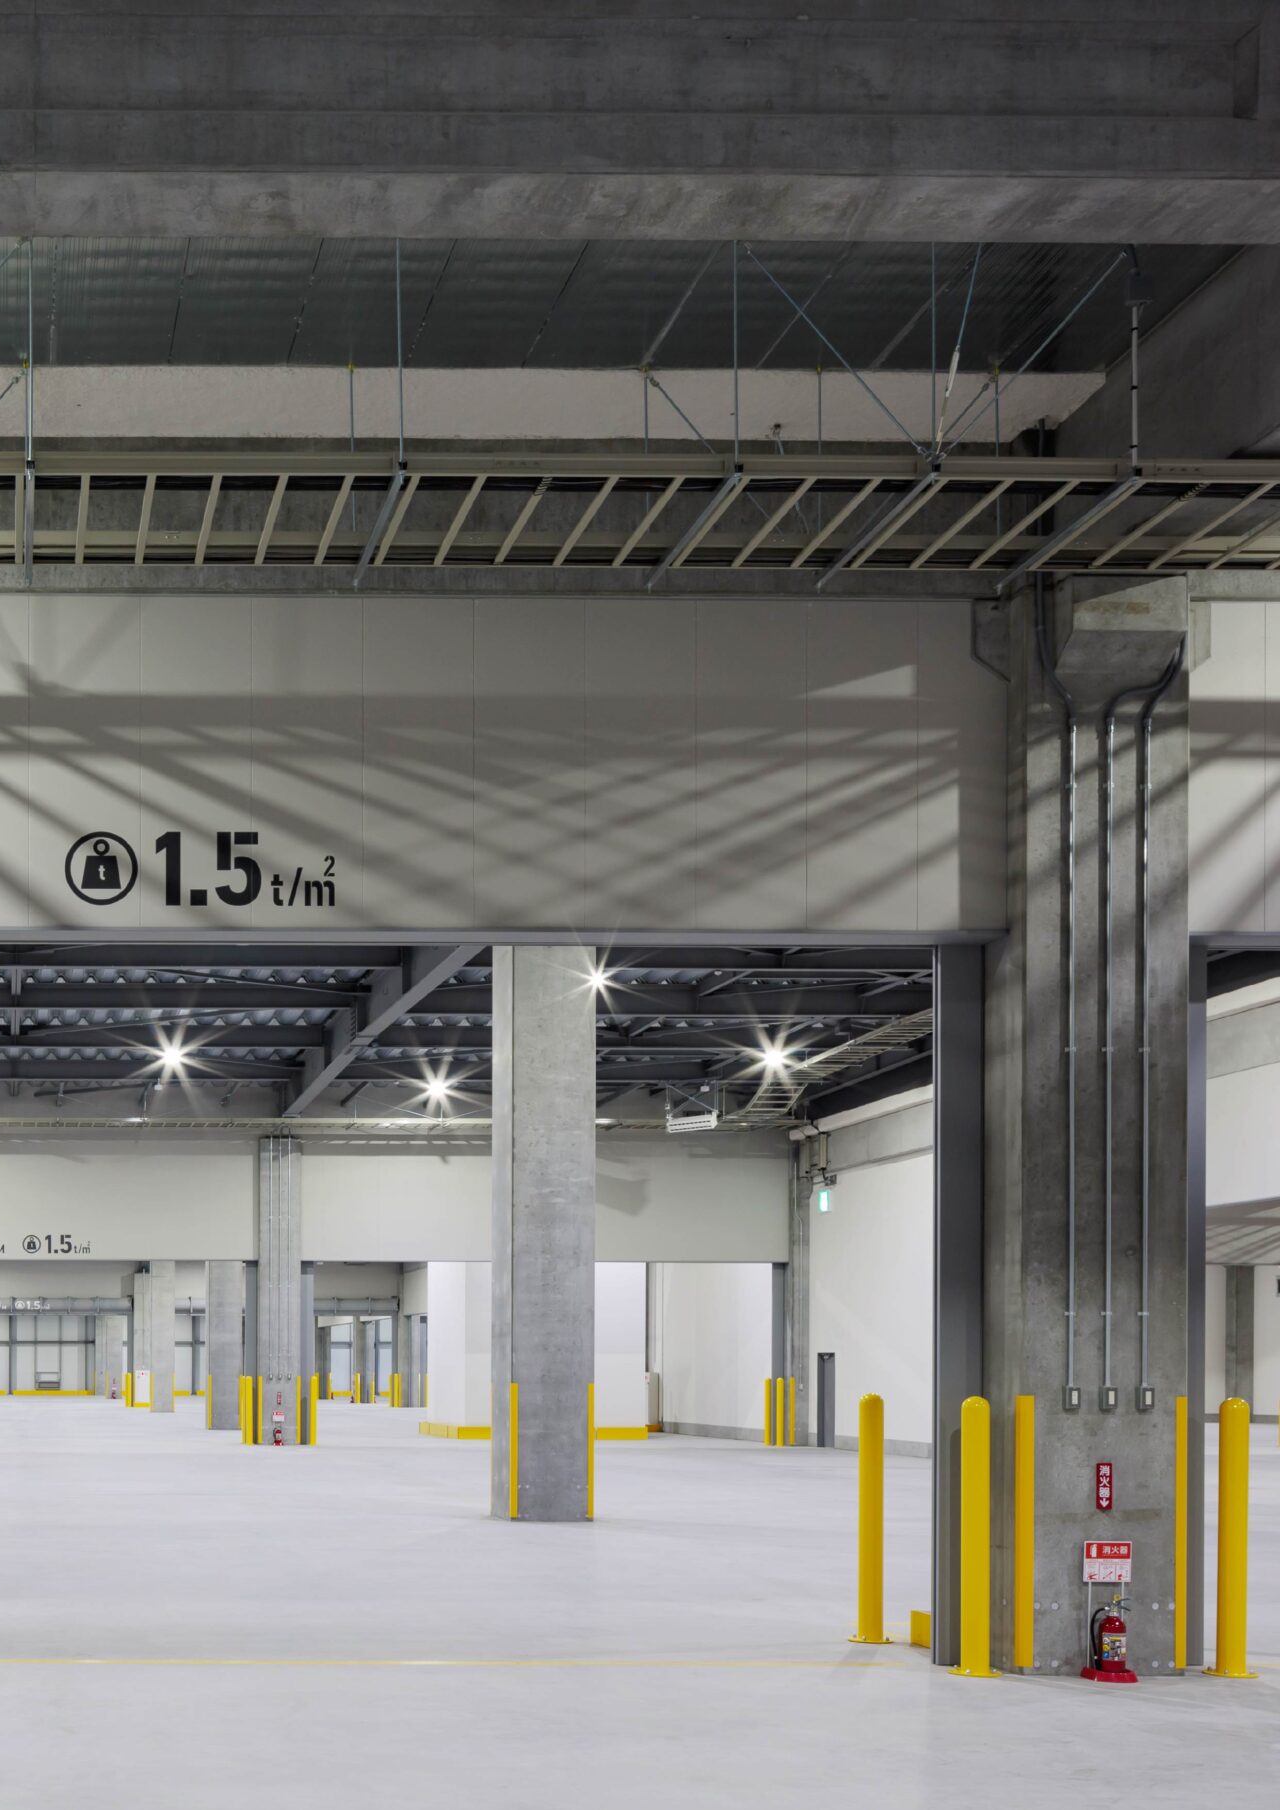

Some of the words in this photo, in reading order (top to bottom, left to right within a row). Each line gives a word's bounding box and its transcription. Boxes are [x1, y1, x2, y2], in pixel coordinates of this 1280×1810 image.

[155, 831, 261, 906] 1.5
[44, 1234, 72, 1254] 1.5
[1099, 1465, 1111, 1498] 消火器
[1102, 1545, 1128, 1554] 消火器
